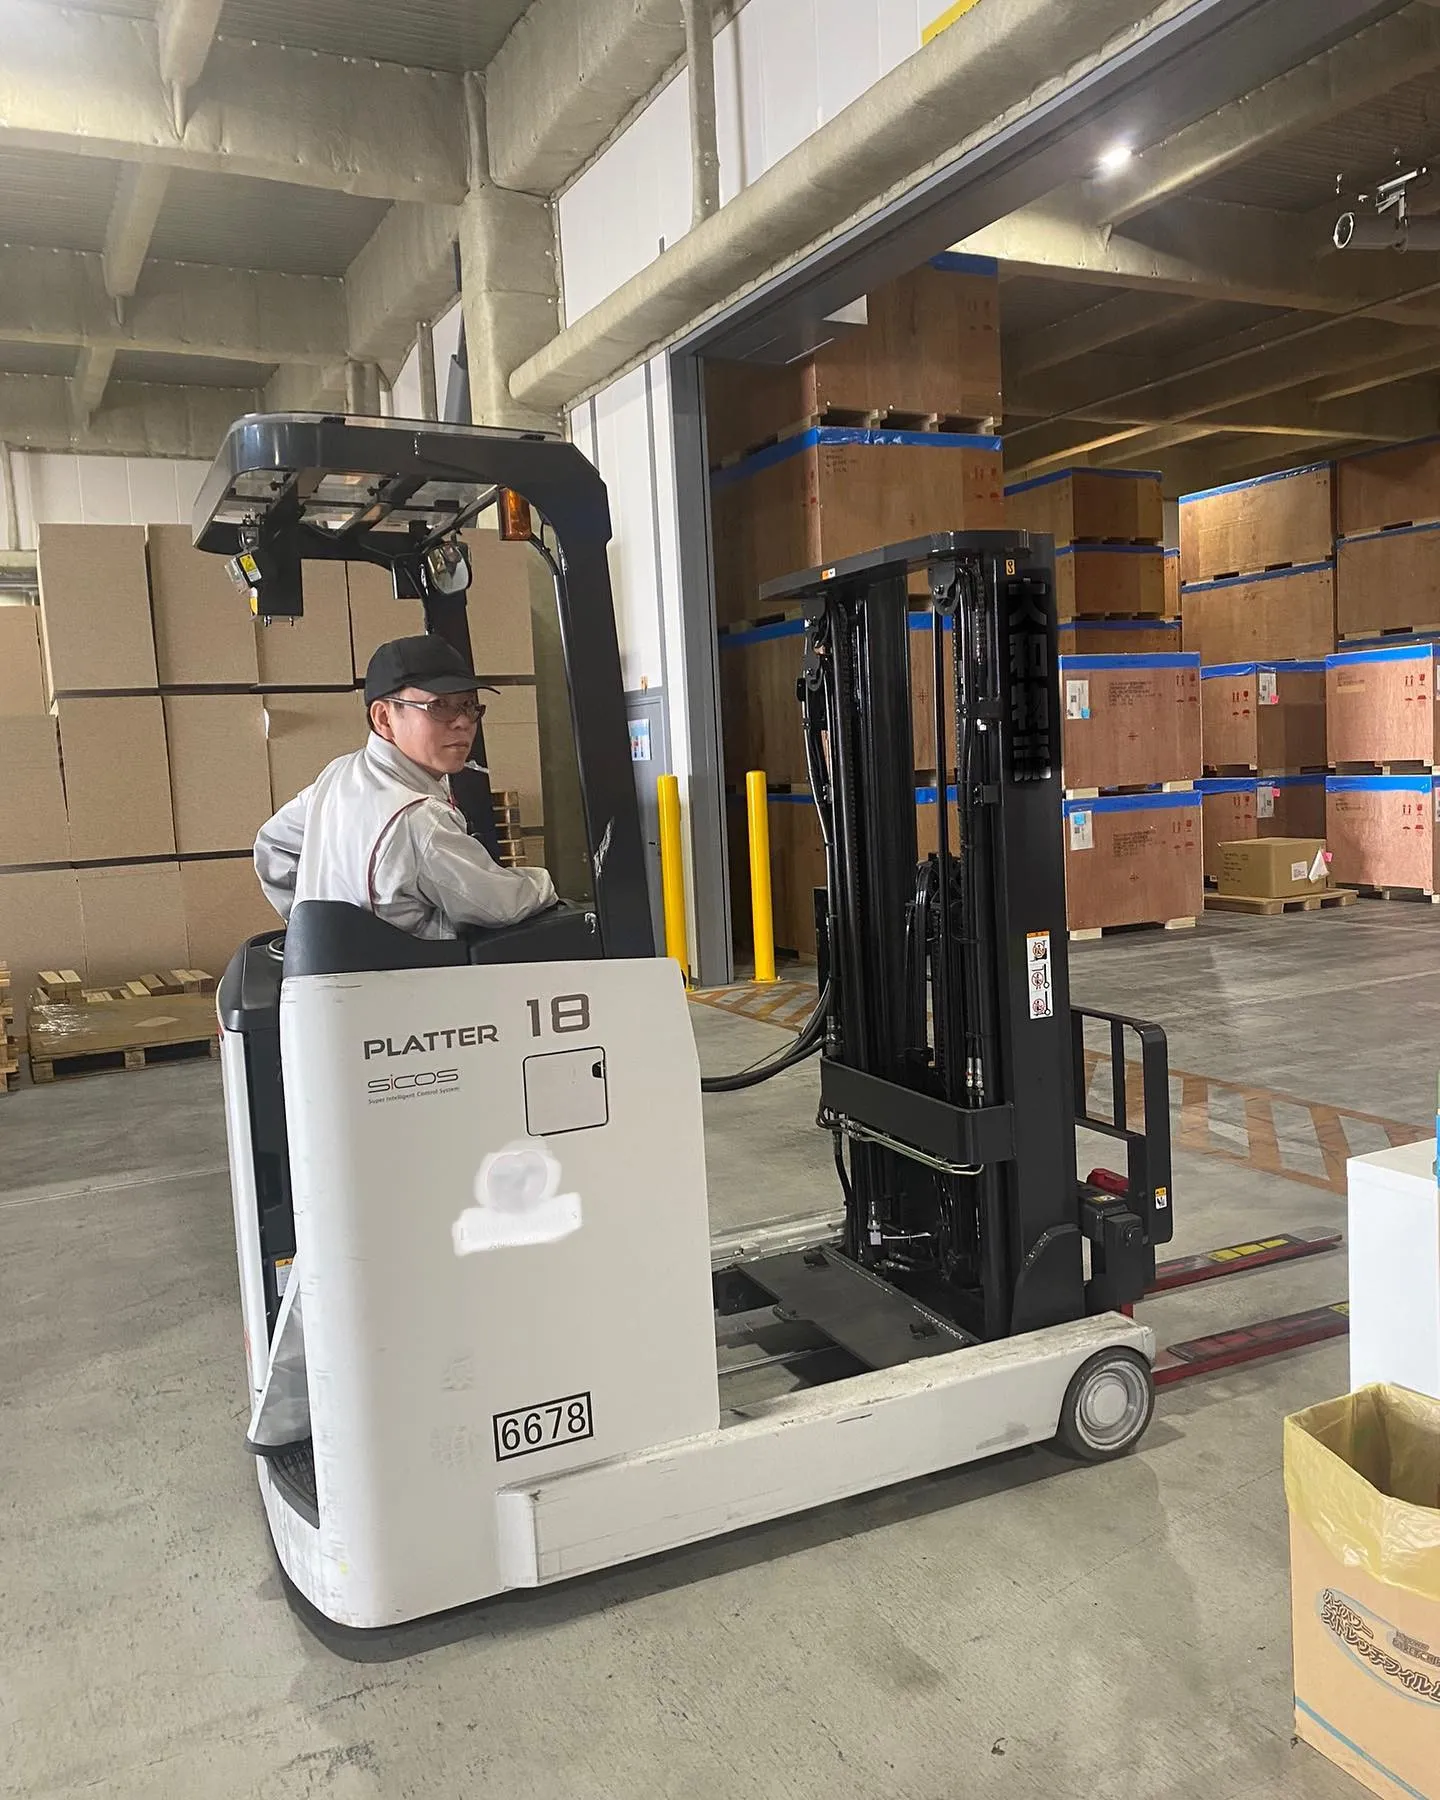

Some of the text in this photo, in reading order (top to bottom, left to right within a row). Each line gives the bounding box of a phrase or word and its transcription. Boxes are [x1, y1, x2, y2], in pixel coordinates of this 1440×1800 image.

[363, 993, 590, 1060] PLATTER 18
[386, 1093, 415, 1102] Intelligent
[439, 1087, 459, 1095] System
[501, 1401, 586, 1450] 6678
[1323, 1589, 1374, 1639] ハイパワー
